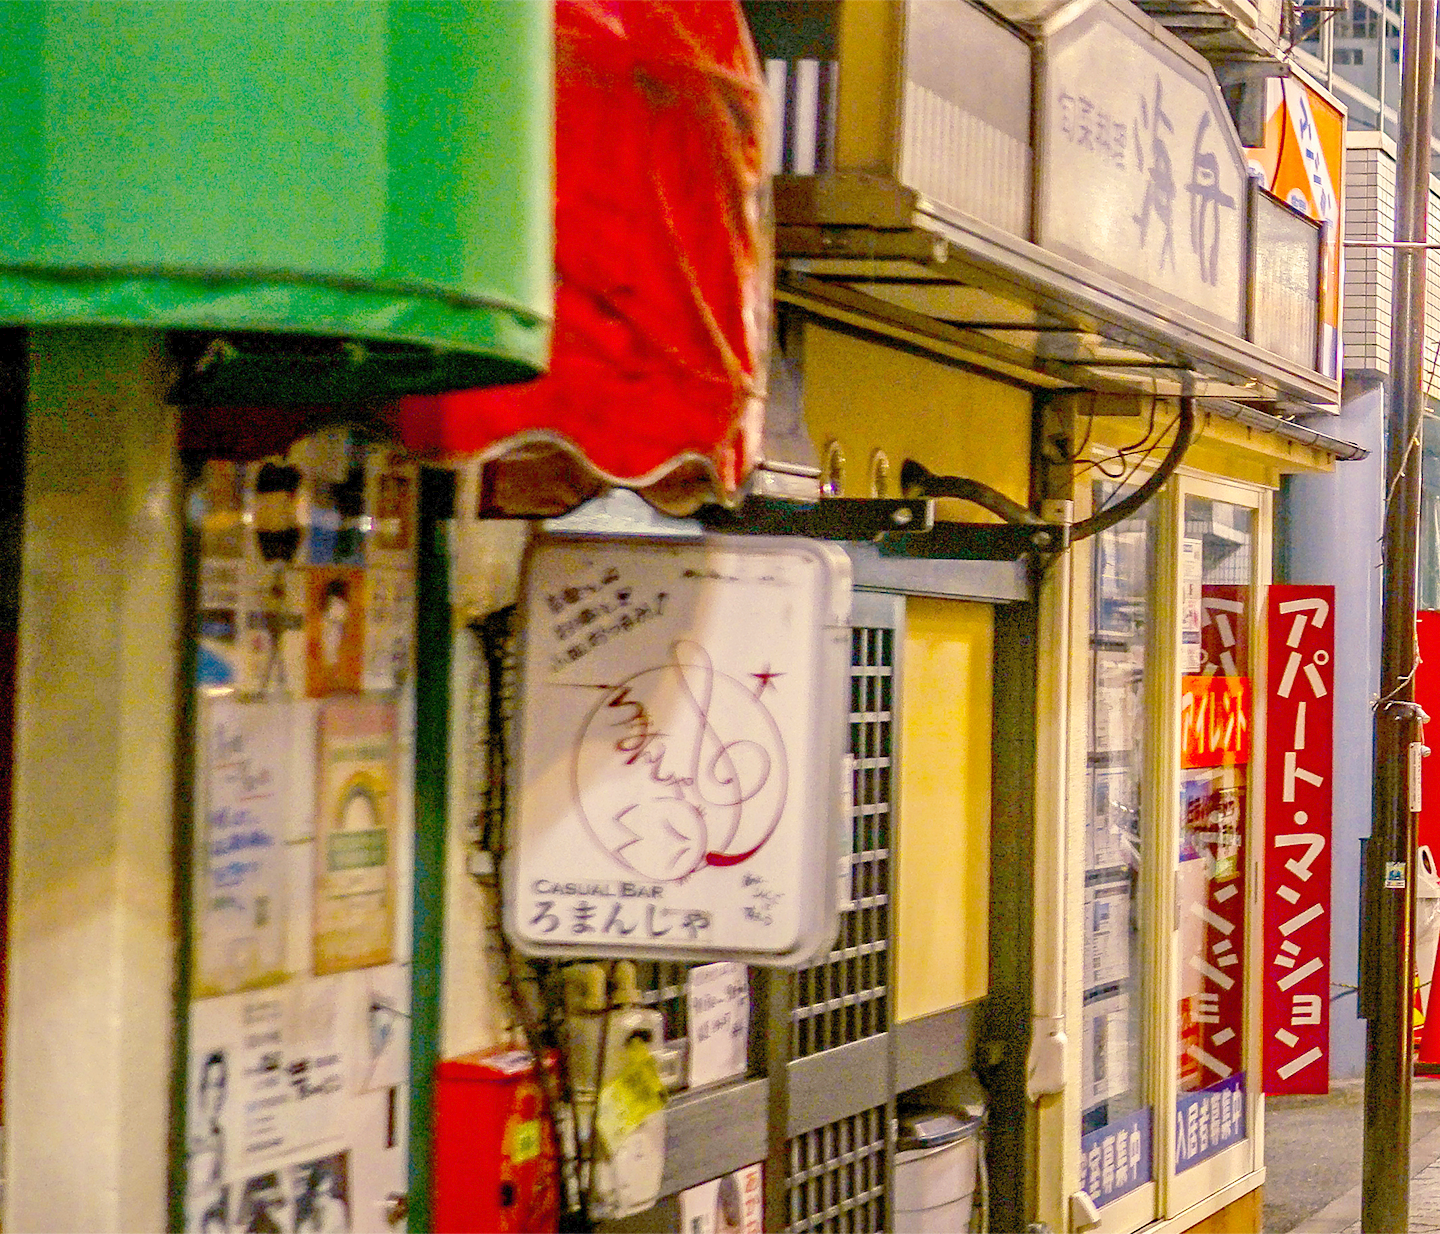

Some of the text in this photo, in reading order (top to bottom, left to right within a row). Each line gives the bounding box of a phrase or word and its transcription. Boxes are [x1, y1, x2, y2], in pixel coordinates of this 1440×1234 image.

[531, 879, 664, 899] CASUAL BAR
[1275, 597, 1330, 1082] アパート・マンション
